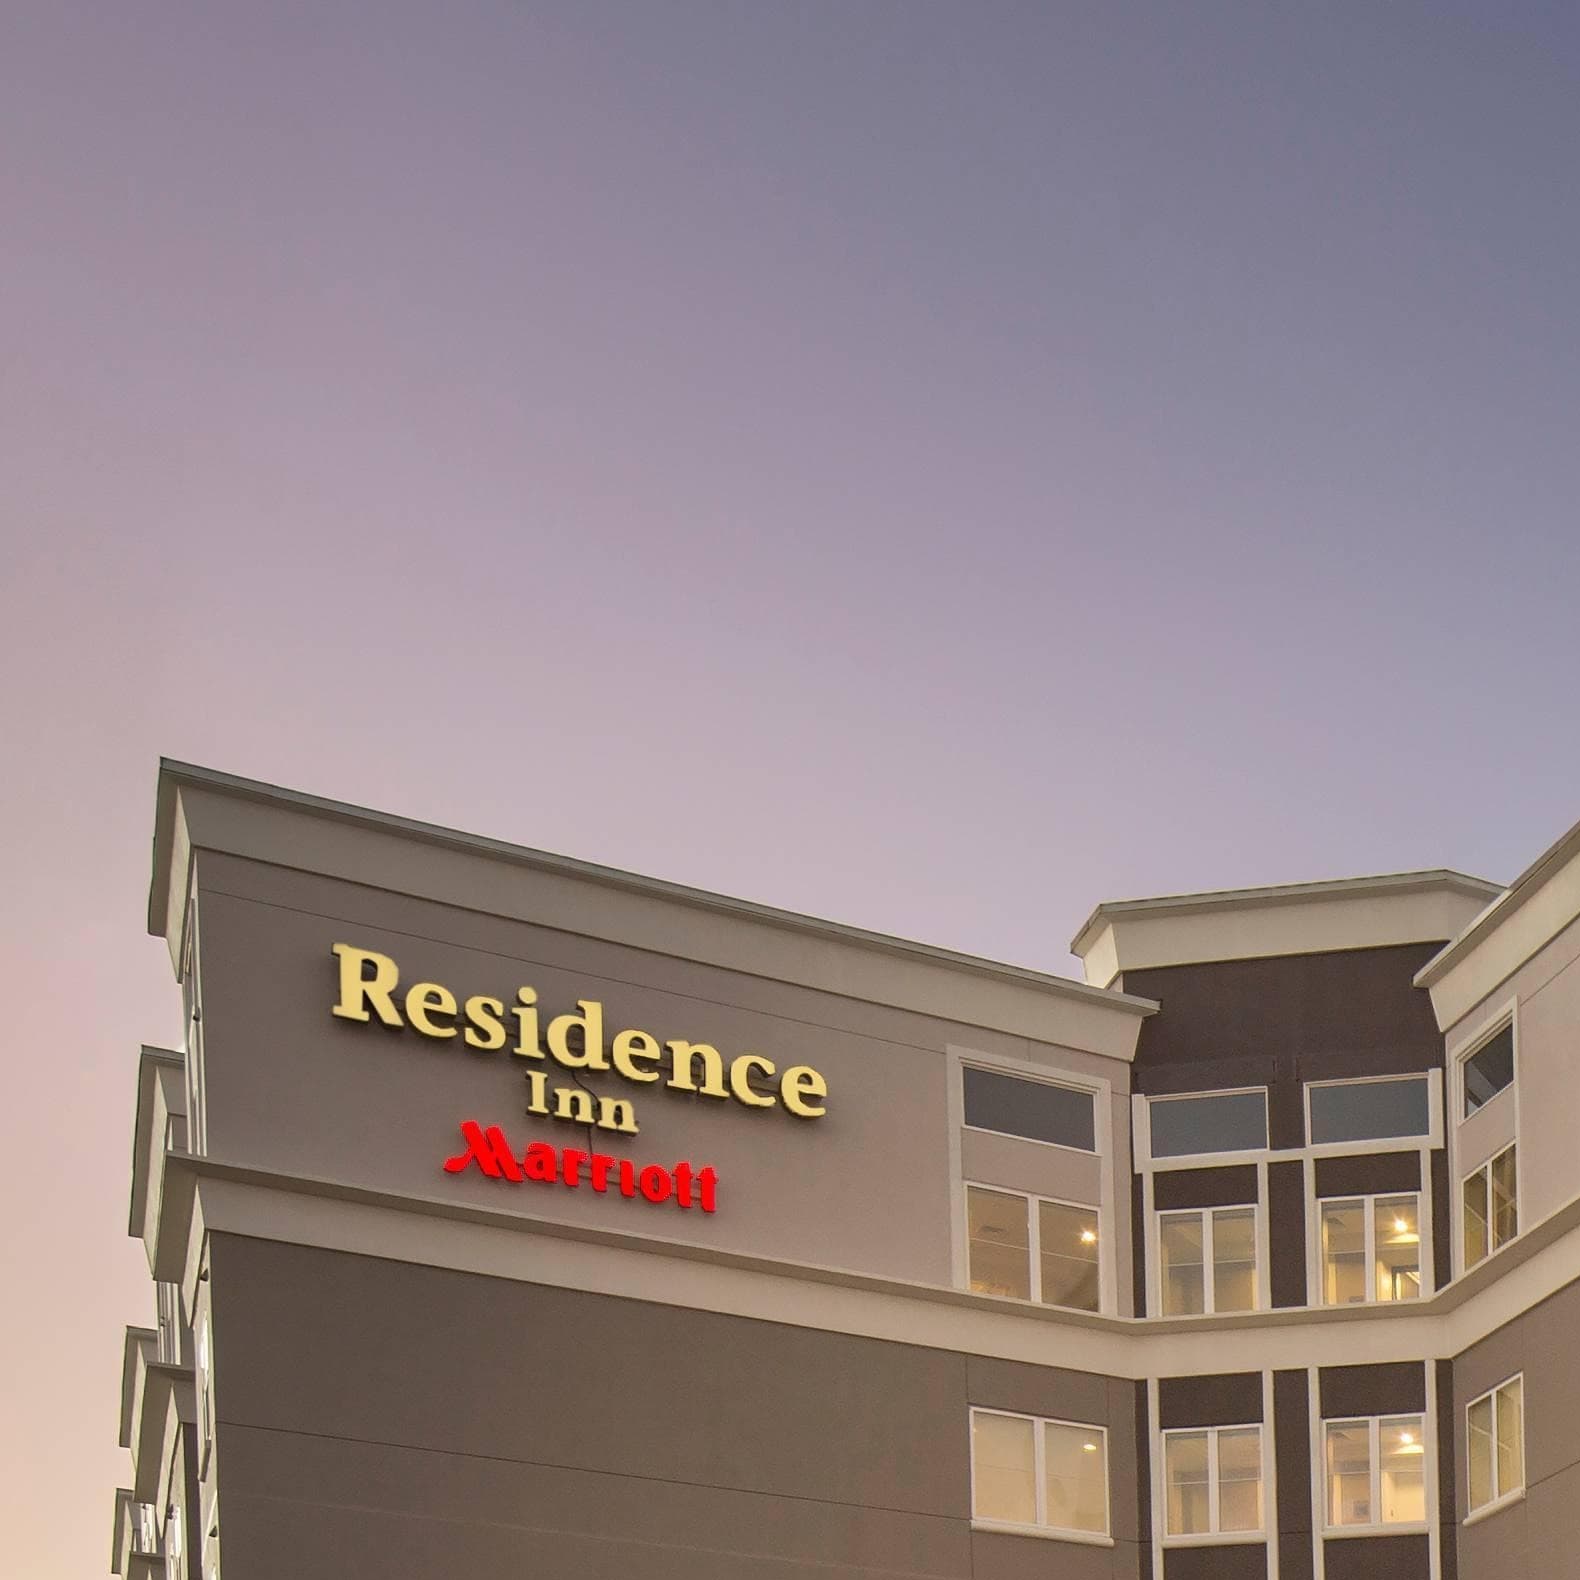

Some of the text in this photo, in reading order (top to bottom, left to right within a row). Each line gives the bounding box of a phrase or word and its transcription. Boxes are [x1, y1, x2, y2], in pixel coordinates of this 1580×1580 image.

[331, 942, 828, 1118] Residence
[524, 1069, 640, 1135] Inn
[443, 1120, 720, 1213] Marriott
